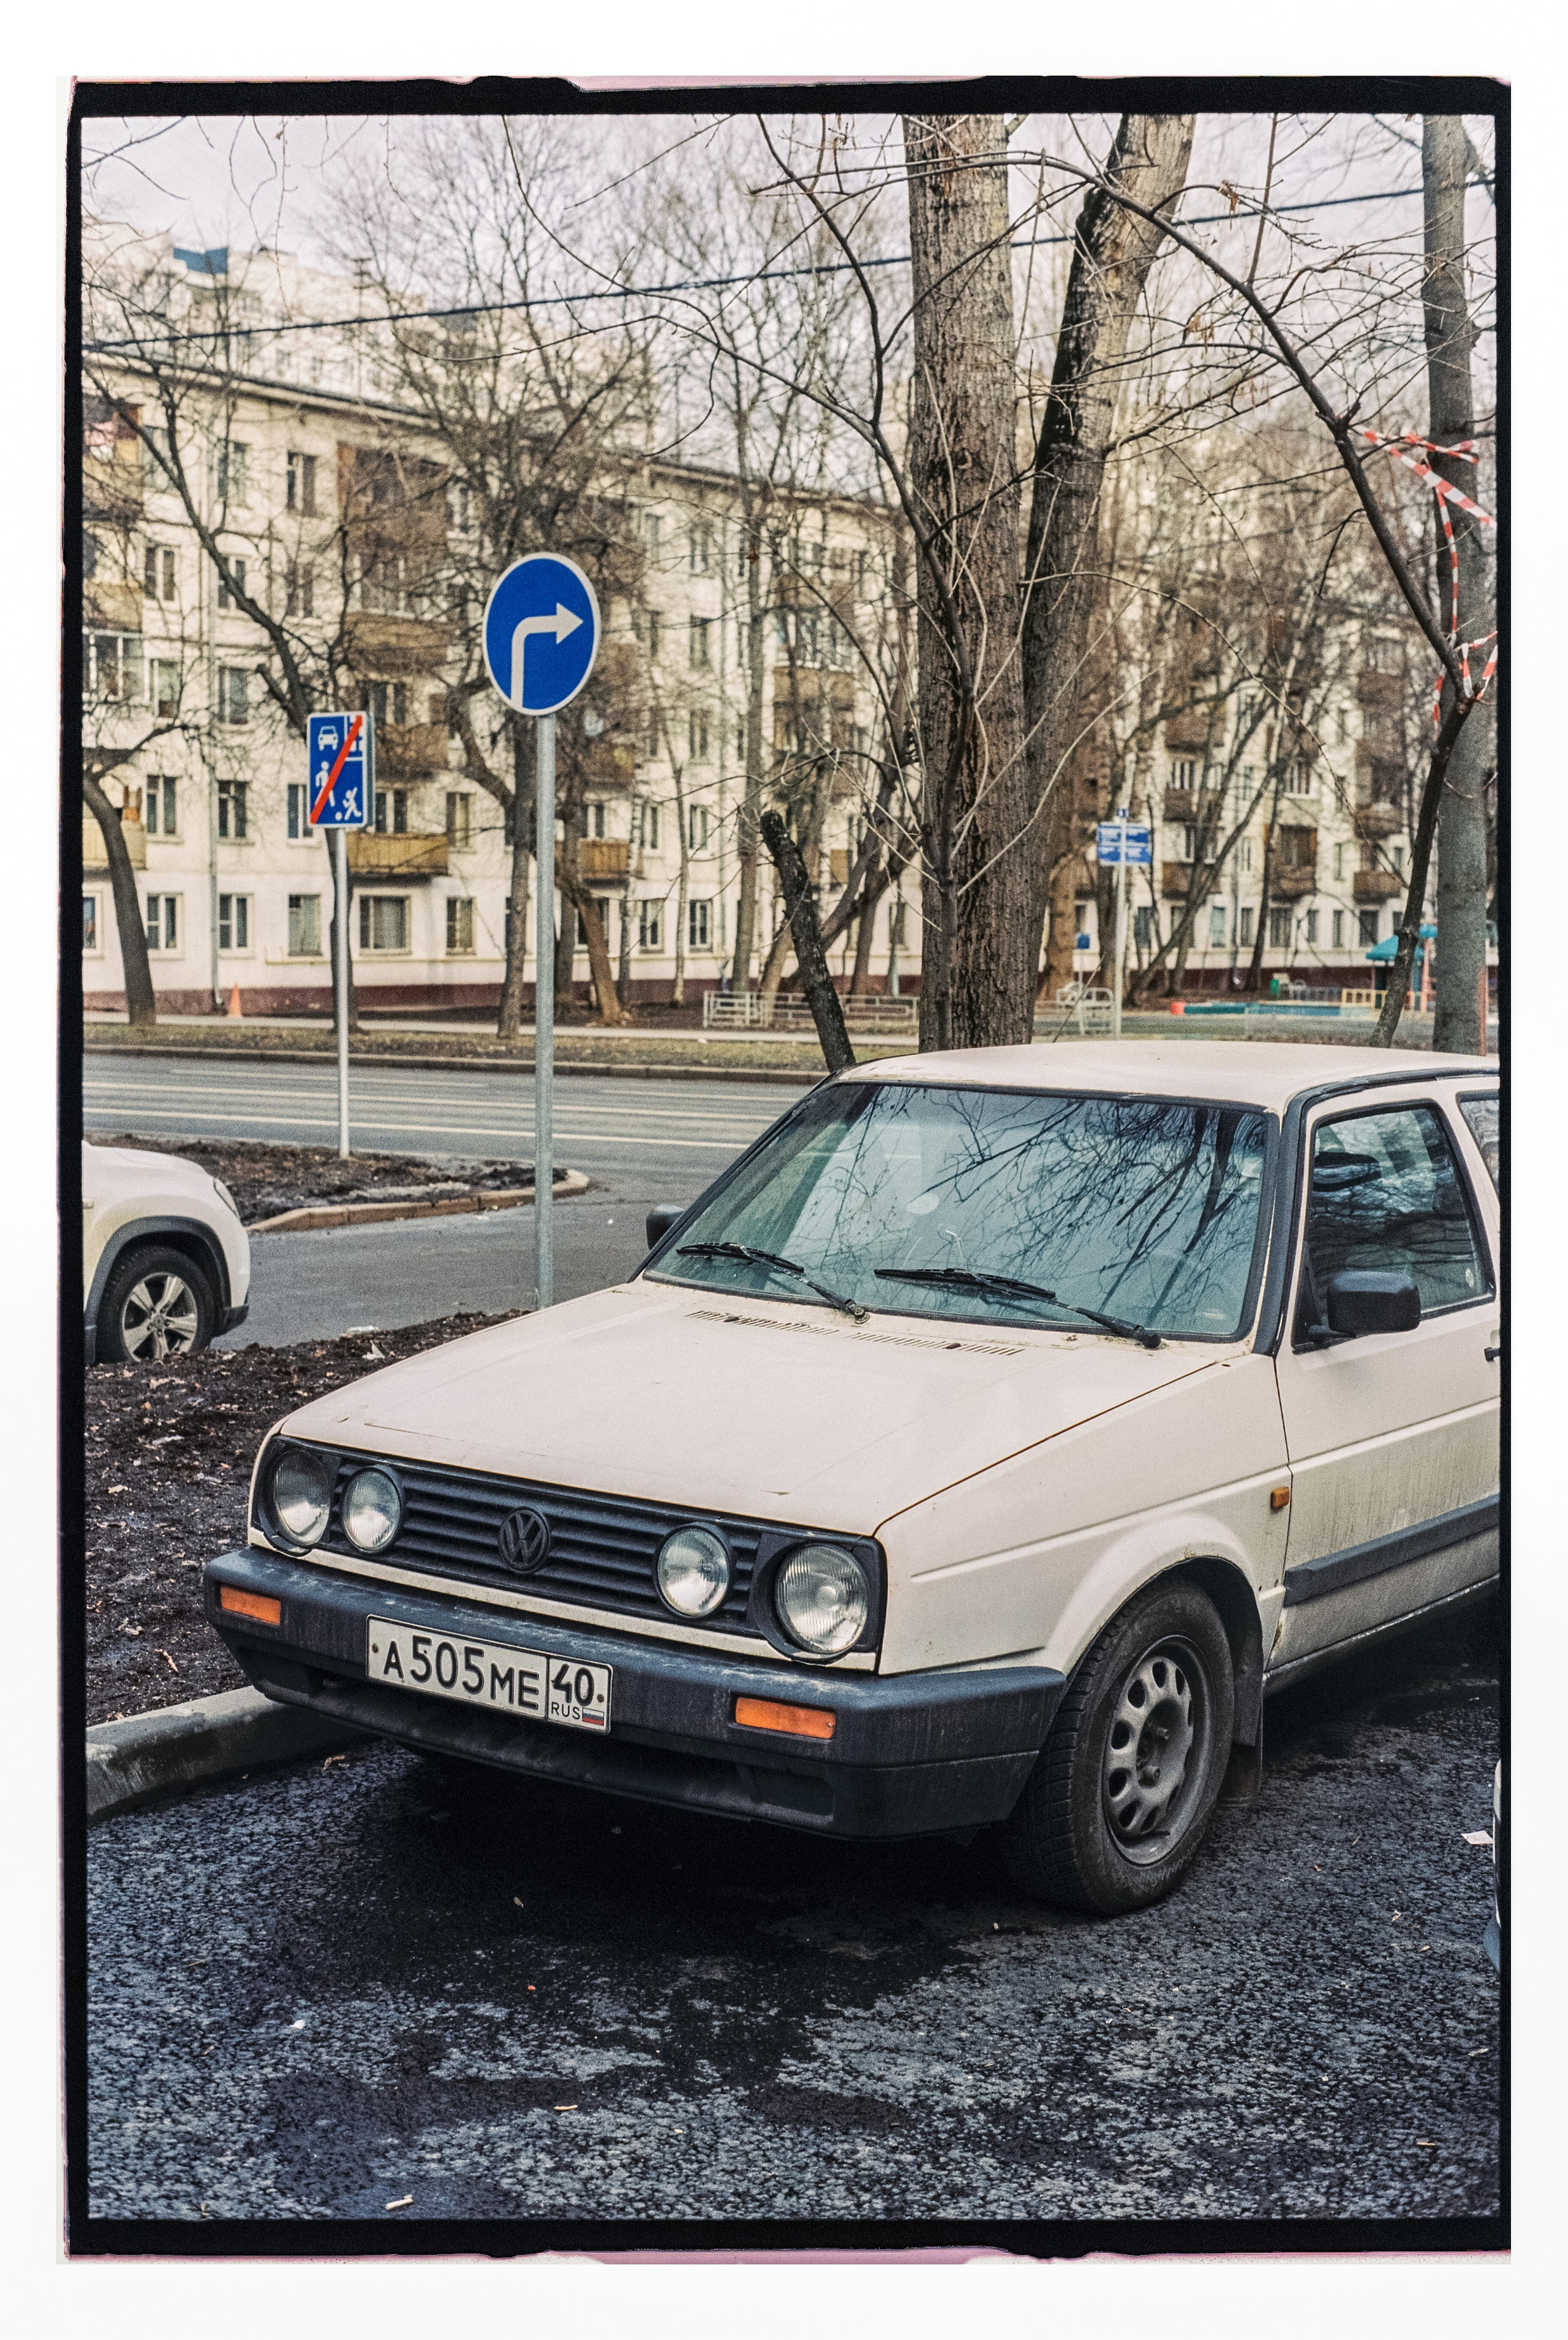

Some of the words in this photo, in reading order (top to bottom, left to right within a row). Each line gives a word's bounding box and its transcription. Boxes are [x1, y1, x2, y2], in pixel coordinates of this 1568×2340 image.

[502, 1509, 548, 1571] VW
[383, 1634, 540, 1710] А505МЕ
[552, 1663, 595, 1707] 40
[551, 1701, 581, 1720] RUS
